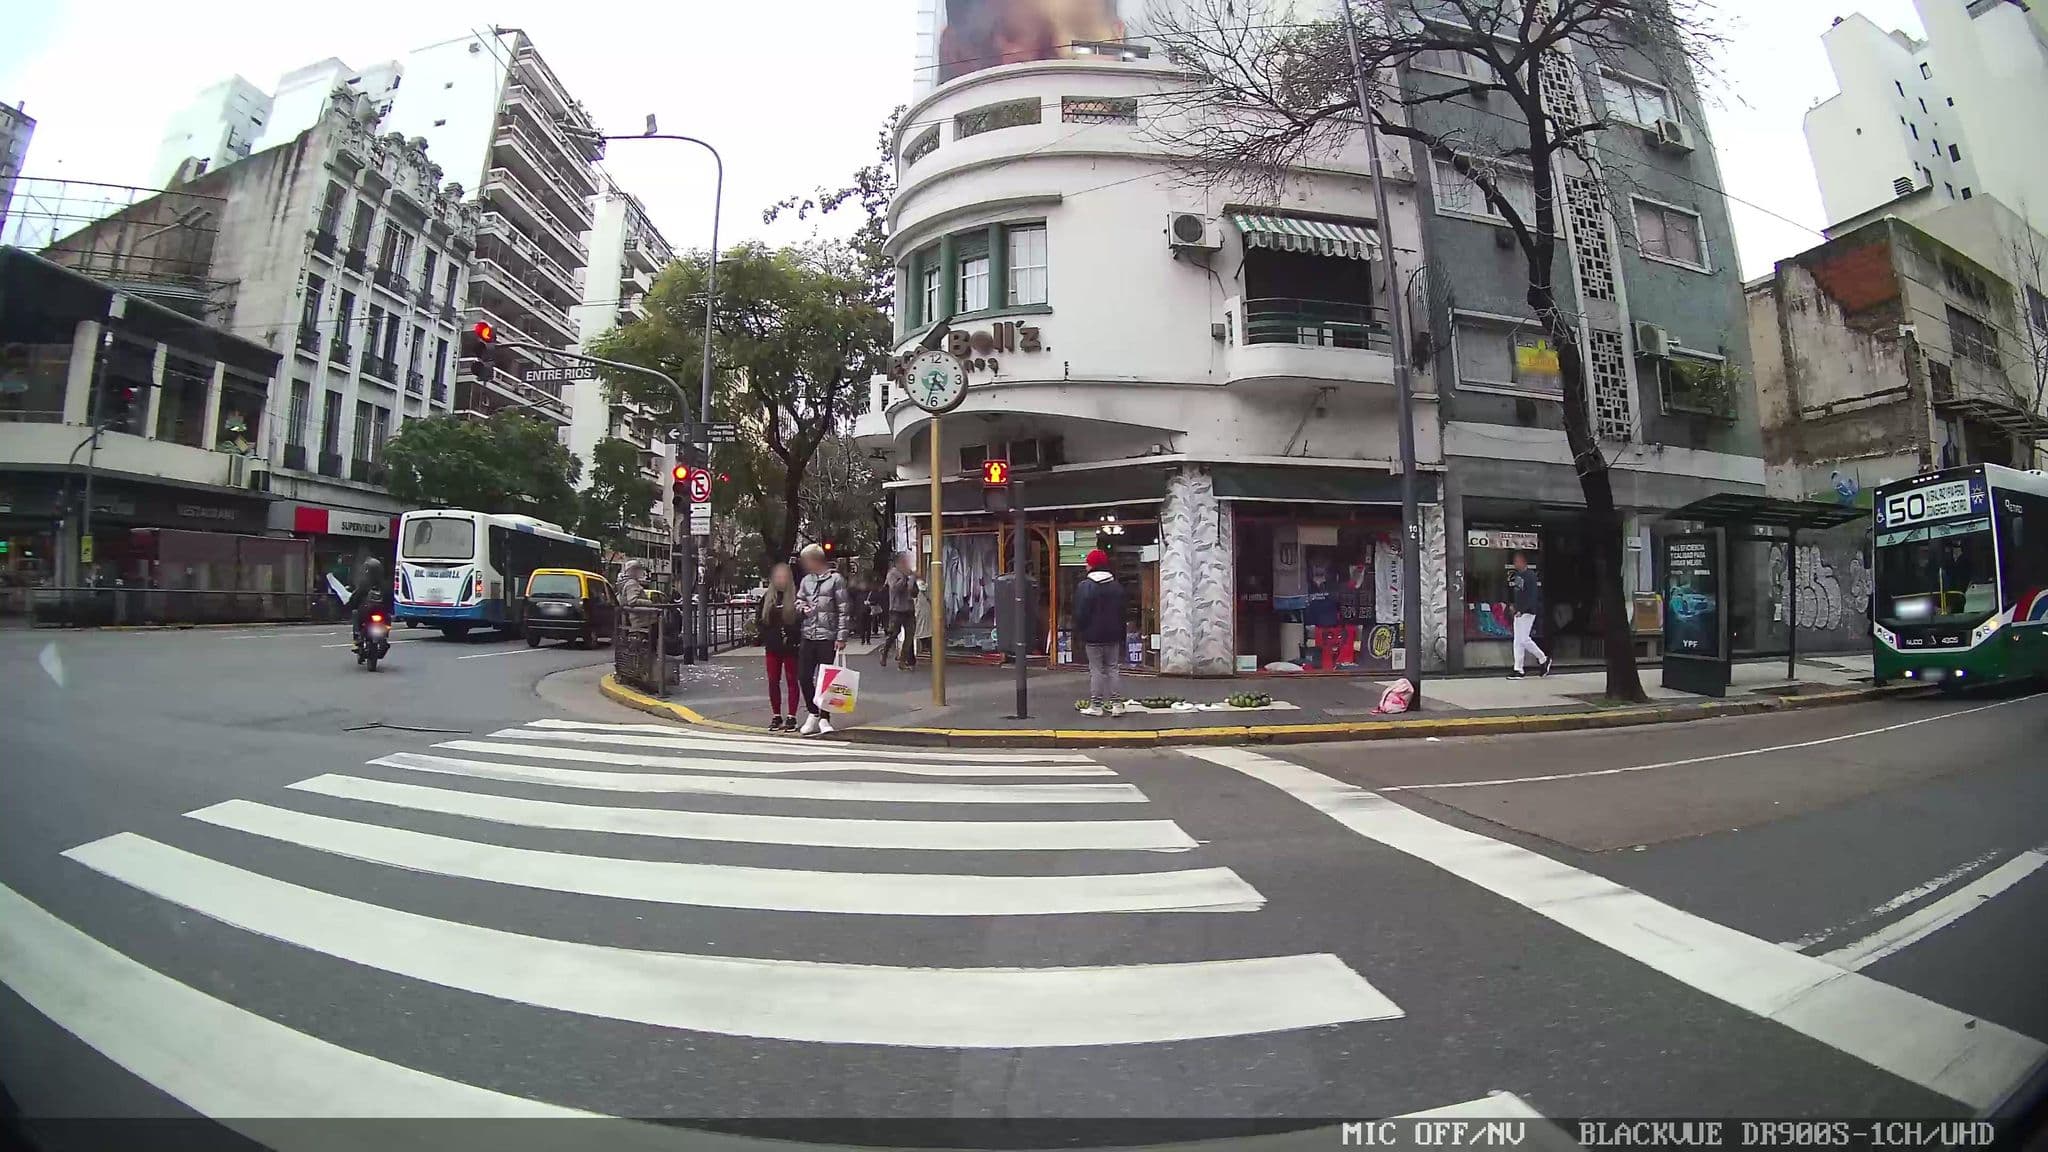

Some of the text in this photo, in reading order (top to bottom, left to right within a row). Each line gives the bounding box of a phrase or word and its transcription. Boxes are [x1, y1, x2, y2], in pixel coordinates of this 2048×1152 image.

[931, 354, 942, 364] 12
[526, 368, 592, 381] ENTRE RIOS
[908, 374, 915, 385] 9
[955, 375, 962, 385] 3
[930, 396, 938, 407] 6
[1889, 493, 1925, 524] 50
[1683, 639, 1698, 648] YPF
